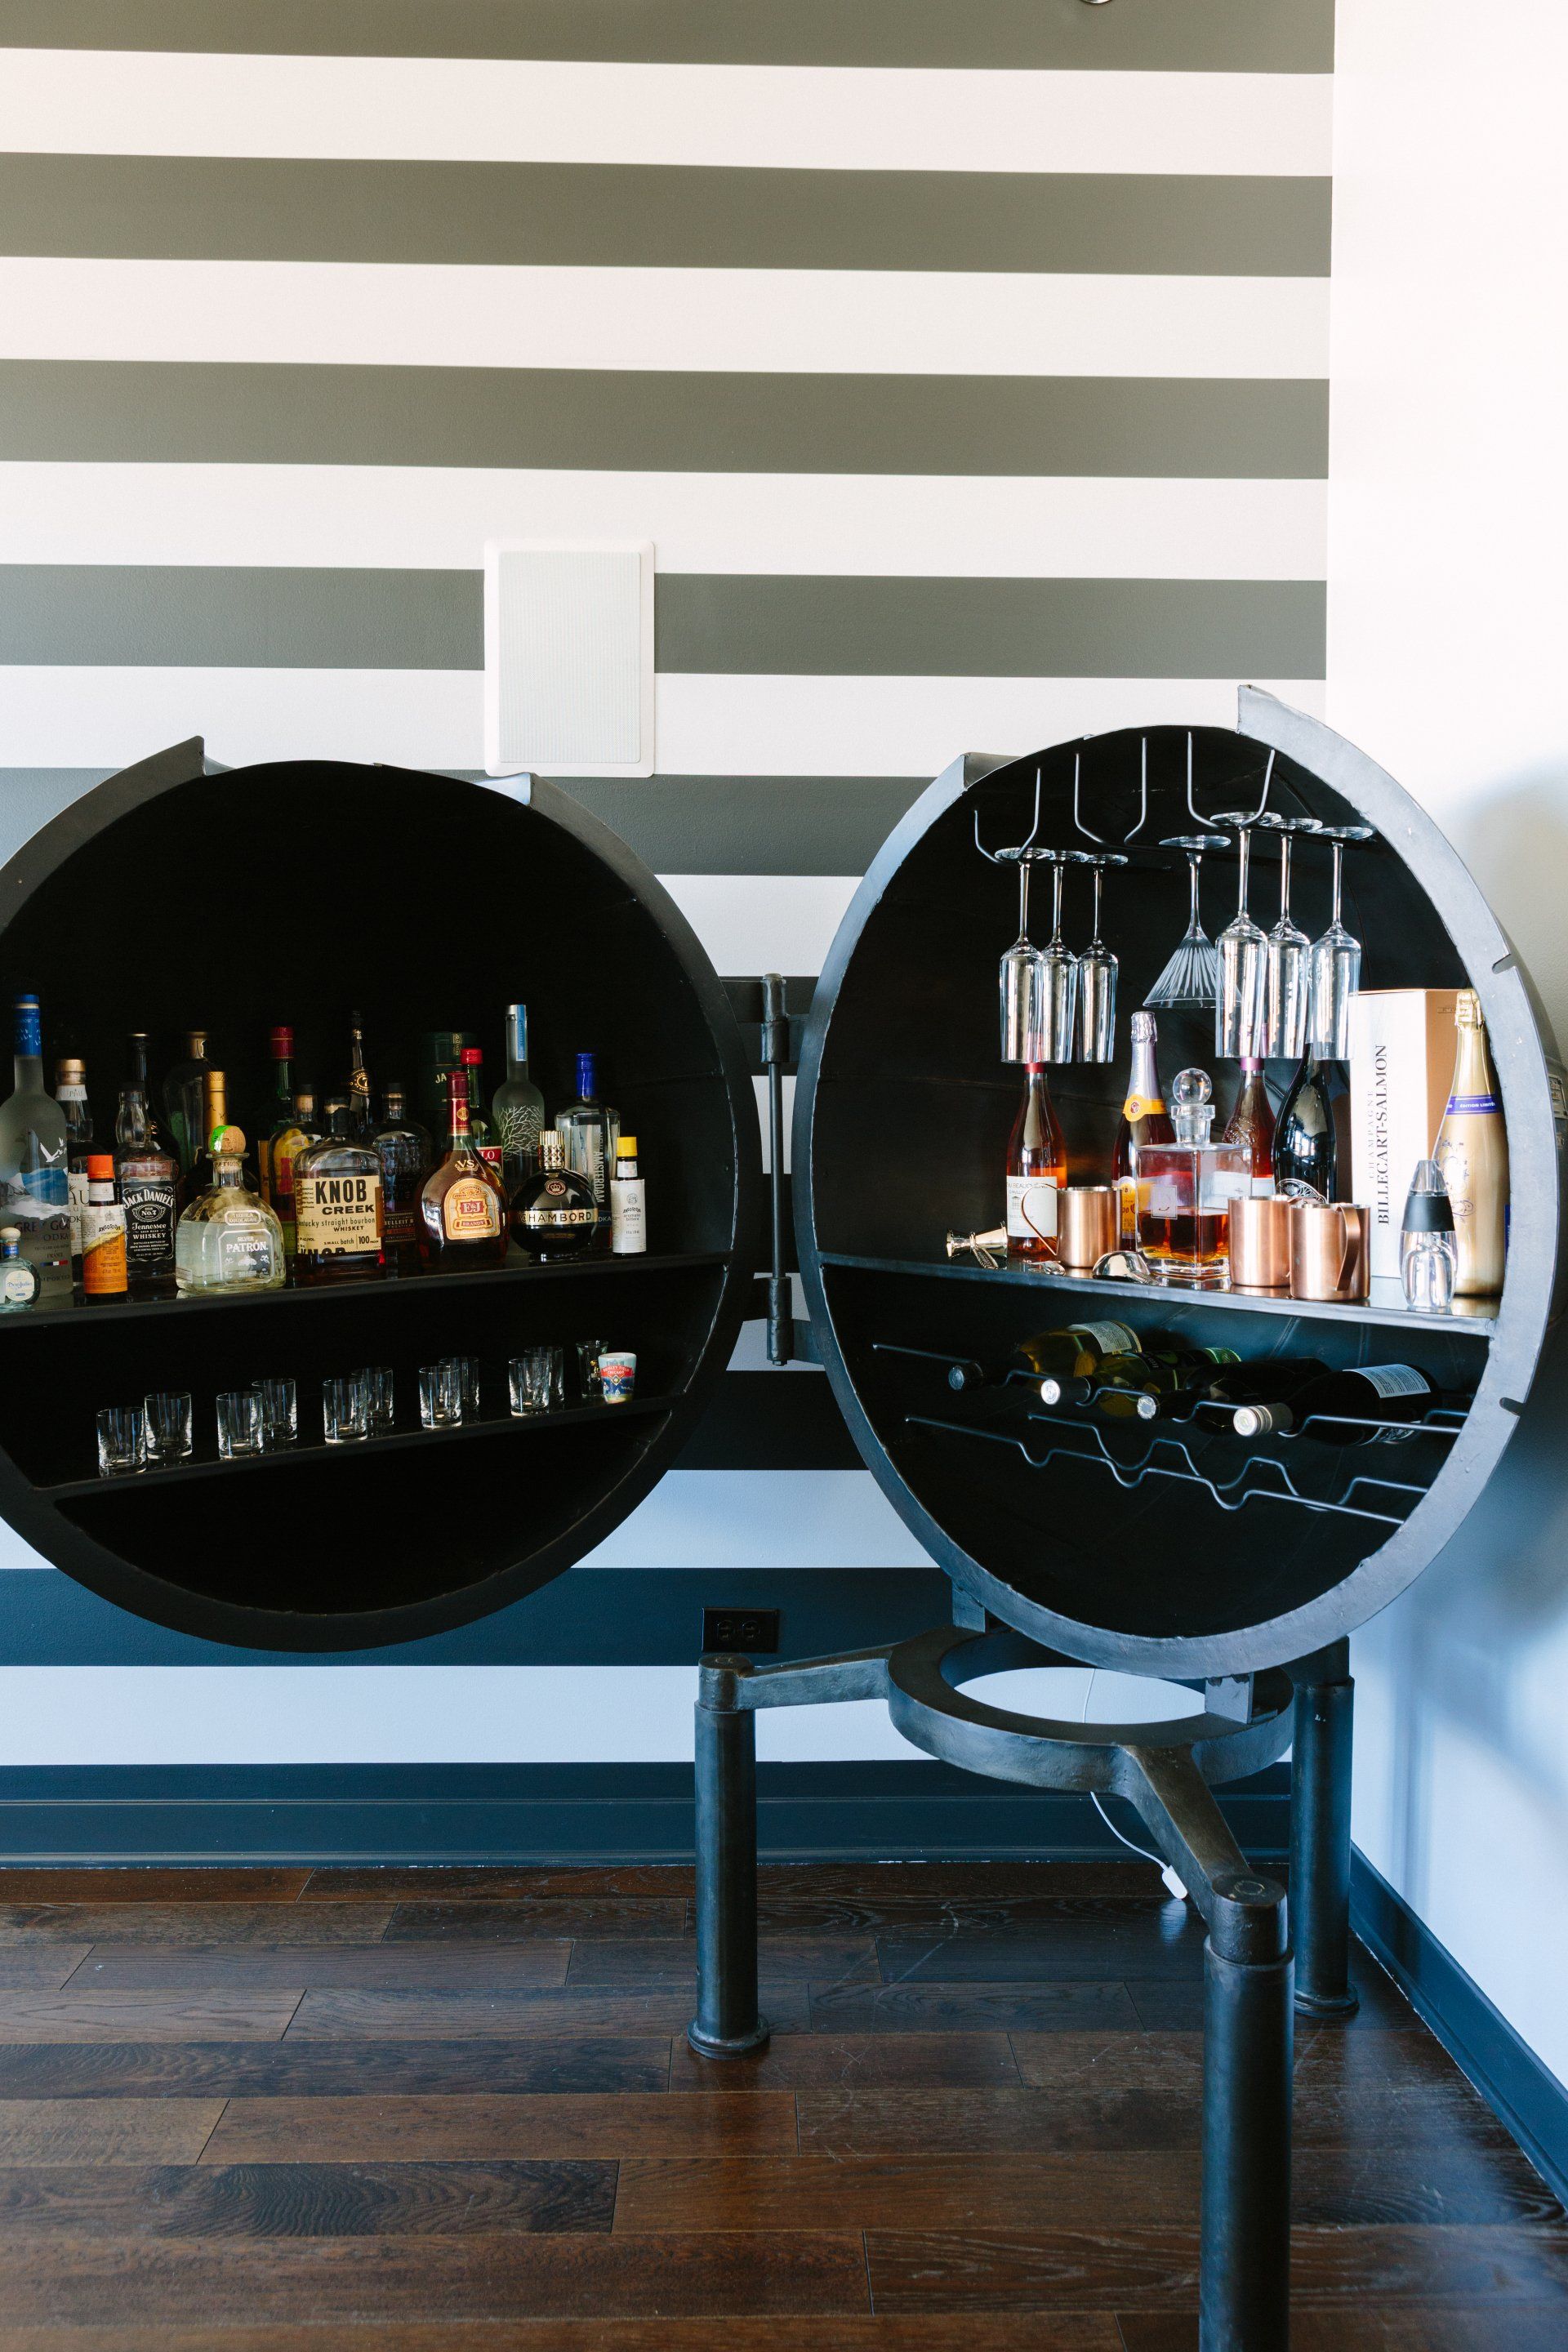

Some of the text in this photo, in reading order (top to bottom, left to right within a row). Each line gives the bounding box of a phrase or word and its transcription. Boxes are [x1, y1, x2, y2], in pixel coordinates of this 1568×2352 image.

[1366, 1090, 1374, 1178] CHAMPAGNE
[1375, 1045, 1390, 1225] BILLECART-SALMON
[457, 1160, 474, 1168] VS
[594, 1152, 605, 1203] AMSTERDAM
[122, 1193, 144, 1209] JACK
[144, 1188, 175, 1208] DANIEL'S
[315, 1179, 368, 1205] KNOB
[322, 1205, 375, 1215] CREEK
[463, 1202, 481, 1213] E&J
[322, 1218, 348, 1229] straight
[350, 1216, 376, 1226] bourbon
[521, 1212, 592, 1223] CHAMBORD
[132, 1223, 167, 1231] Tennessee
[226, 1240, 268, 1254] PATRÓN
[358, 1236, 370, 1245] 100
